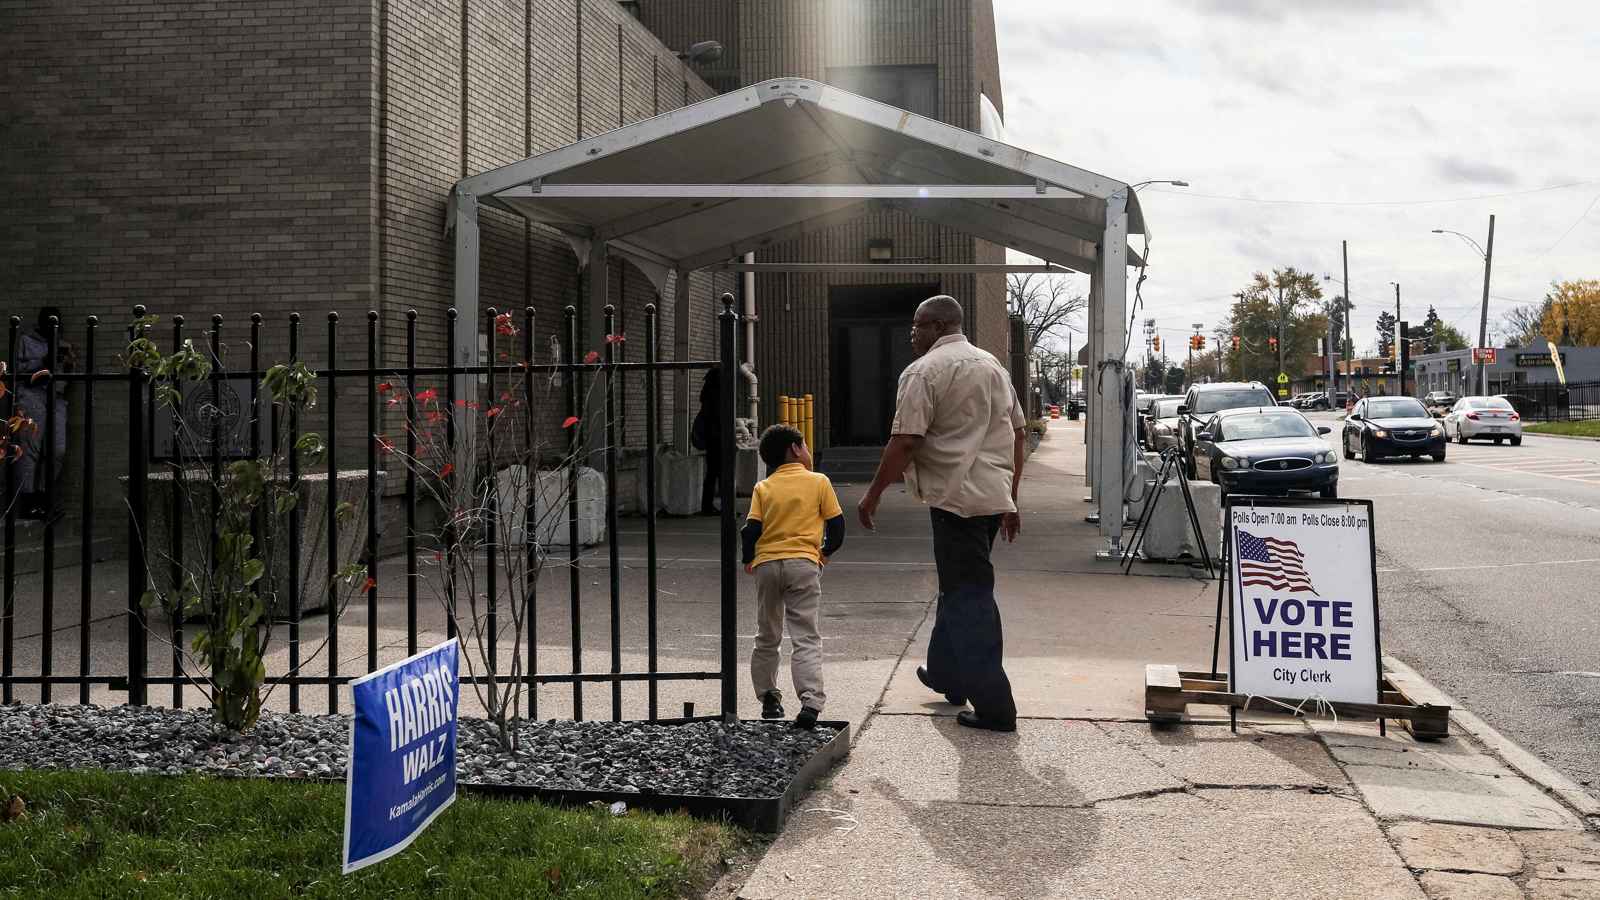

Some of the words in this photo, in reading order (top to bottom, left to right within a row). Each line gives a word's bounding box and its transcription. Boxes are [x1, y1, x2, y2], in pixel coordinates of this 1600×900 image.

[1233, 511, 1249, 524] Polls
[1251, 511, 1269, 526] Open
[1287, 515, 1297, 525] am
[1302, 513, 1319, 526] Polls
[1320, 514, 1340, 526] Close
[1341, 515, 1355, 528] 8:00
[1357, 518, 1368, 530] pm
[1253, 598, 1353, 628] VOTE
[1253, 630, 1352, 661] HERE
[1273, 668, 1297, 684] City
[1300, 669, 1331, 683] Clerk
[386, 665, 453, 751] HARRIS
[402, 732, 448, 785] WALZ
